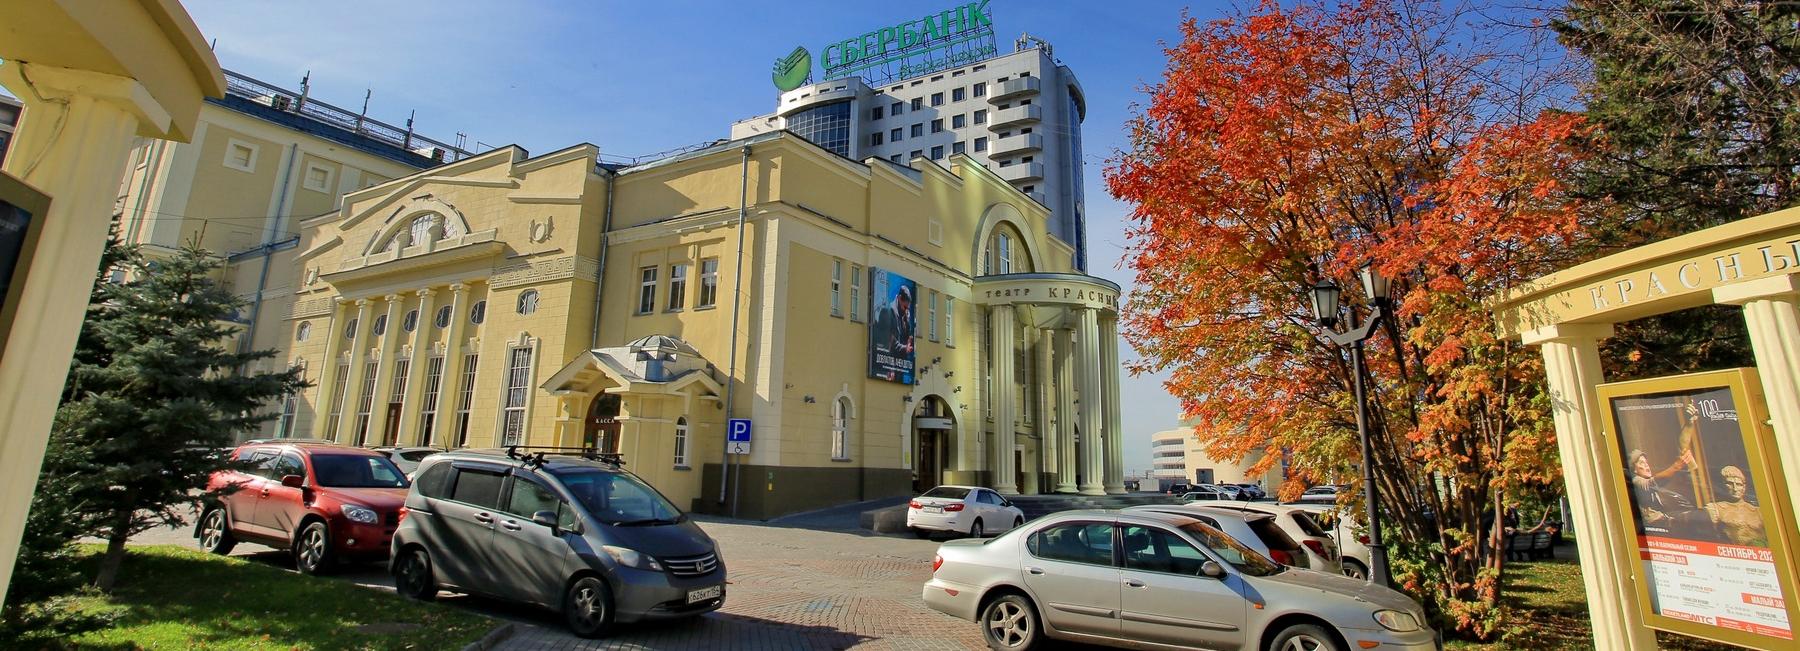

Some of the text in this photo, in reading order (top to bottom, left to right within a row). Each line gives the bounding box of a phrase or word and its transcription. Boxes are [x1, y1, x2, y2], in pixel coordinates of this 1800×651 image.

[820, 0, 992, 70] СБЕРБАНК
[1589, 240, 1800, 310] КРАСНЫ
[985, 288, 1030, 298] театр
[1698, 399, 1719, 417] 100
[733, 421, 747, 440] P
[1717, 545, 1758, 559] СЕНТЯБРЬ
